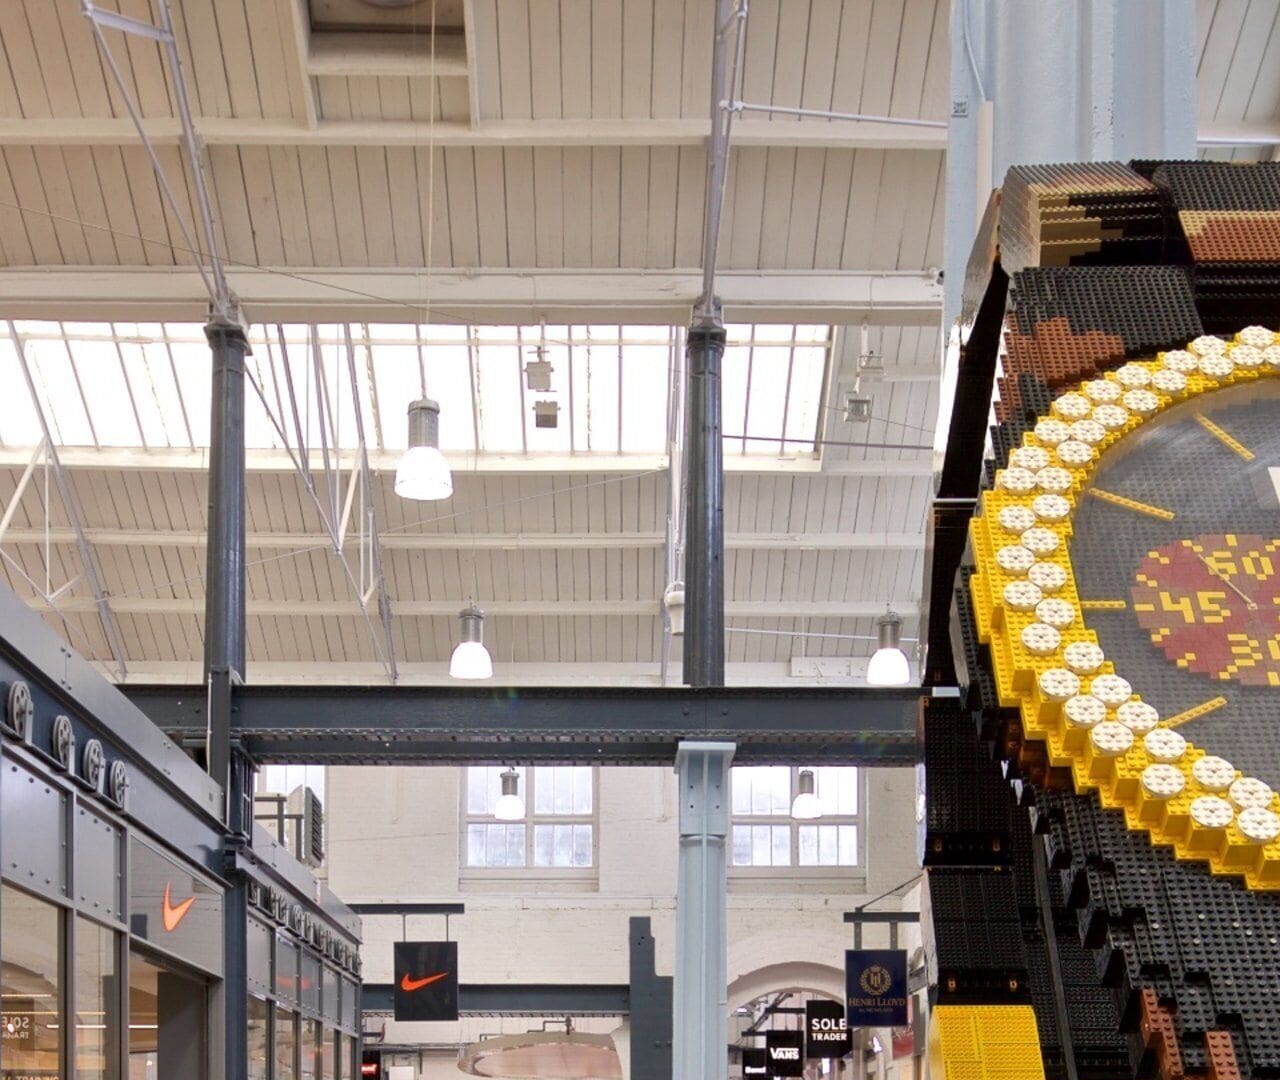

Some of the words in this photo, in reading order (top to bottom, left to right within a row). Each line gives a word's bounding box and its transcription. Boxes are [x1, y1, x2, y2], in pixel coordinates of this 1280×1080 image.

[1160, 591, 1232, 623] 45
[811, 1018, 847, 1030] SOLE
[811, 1032, 847, 1042] TRADER
[769, 1047, 800, 1060] VANS
